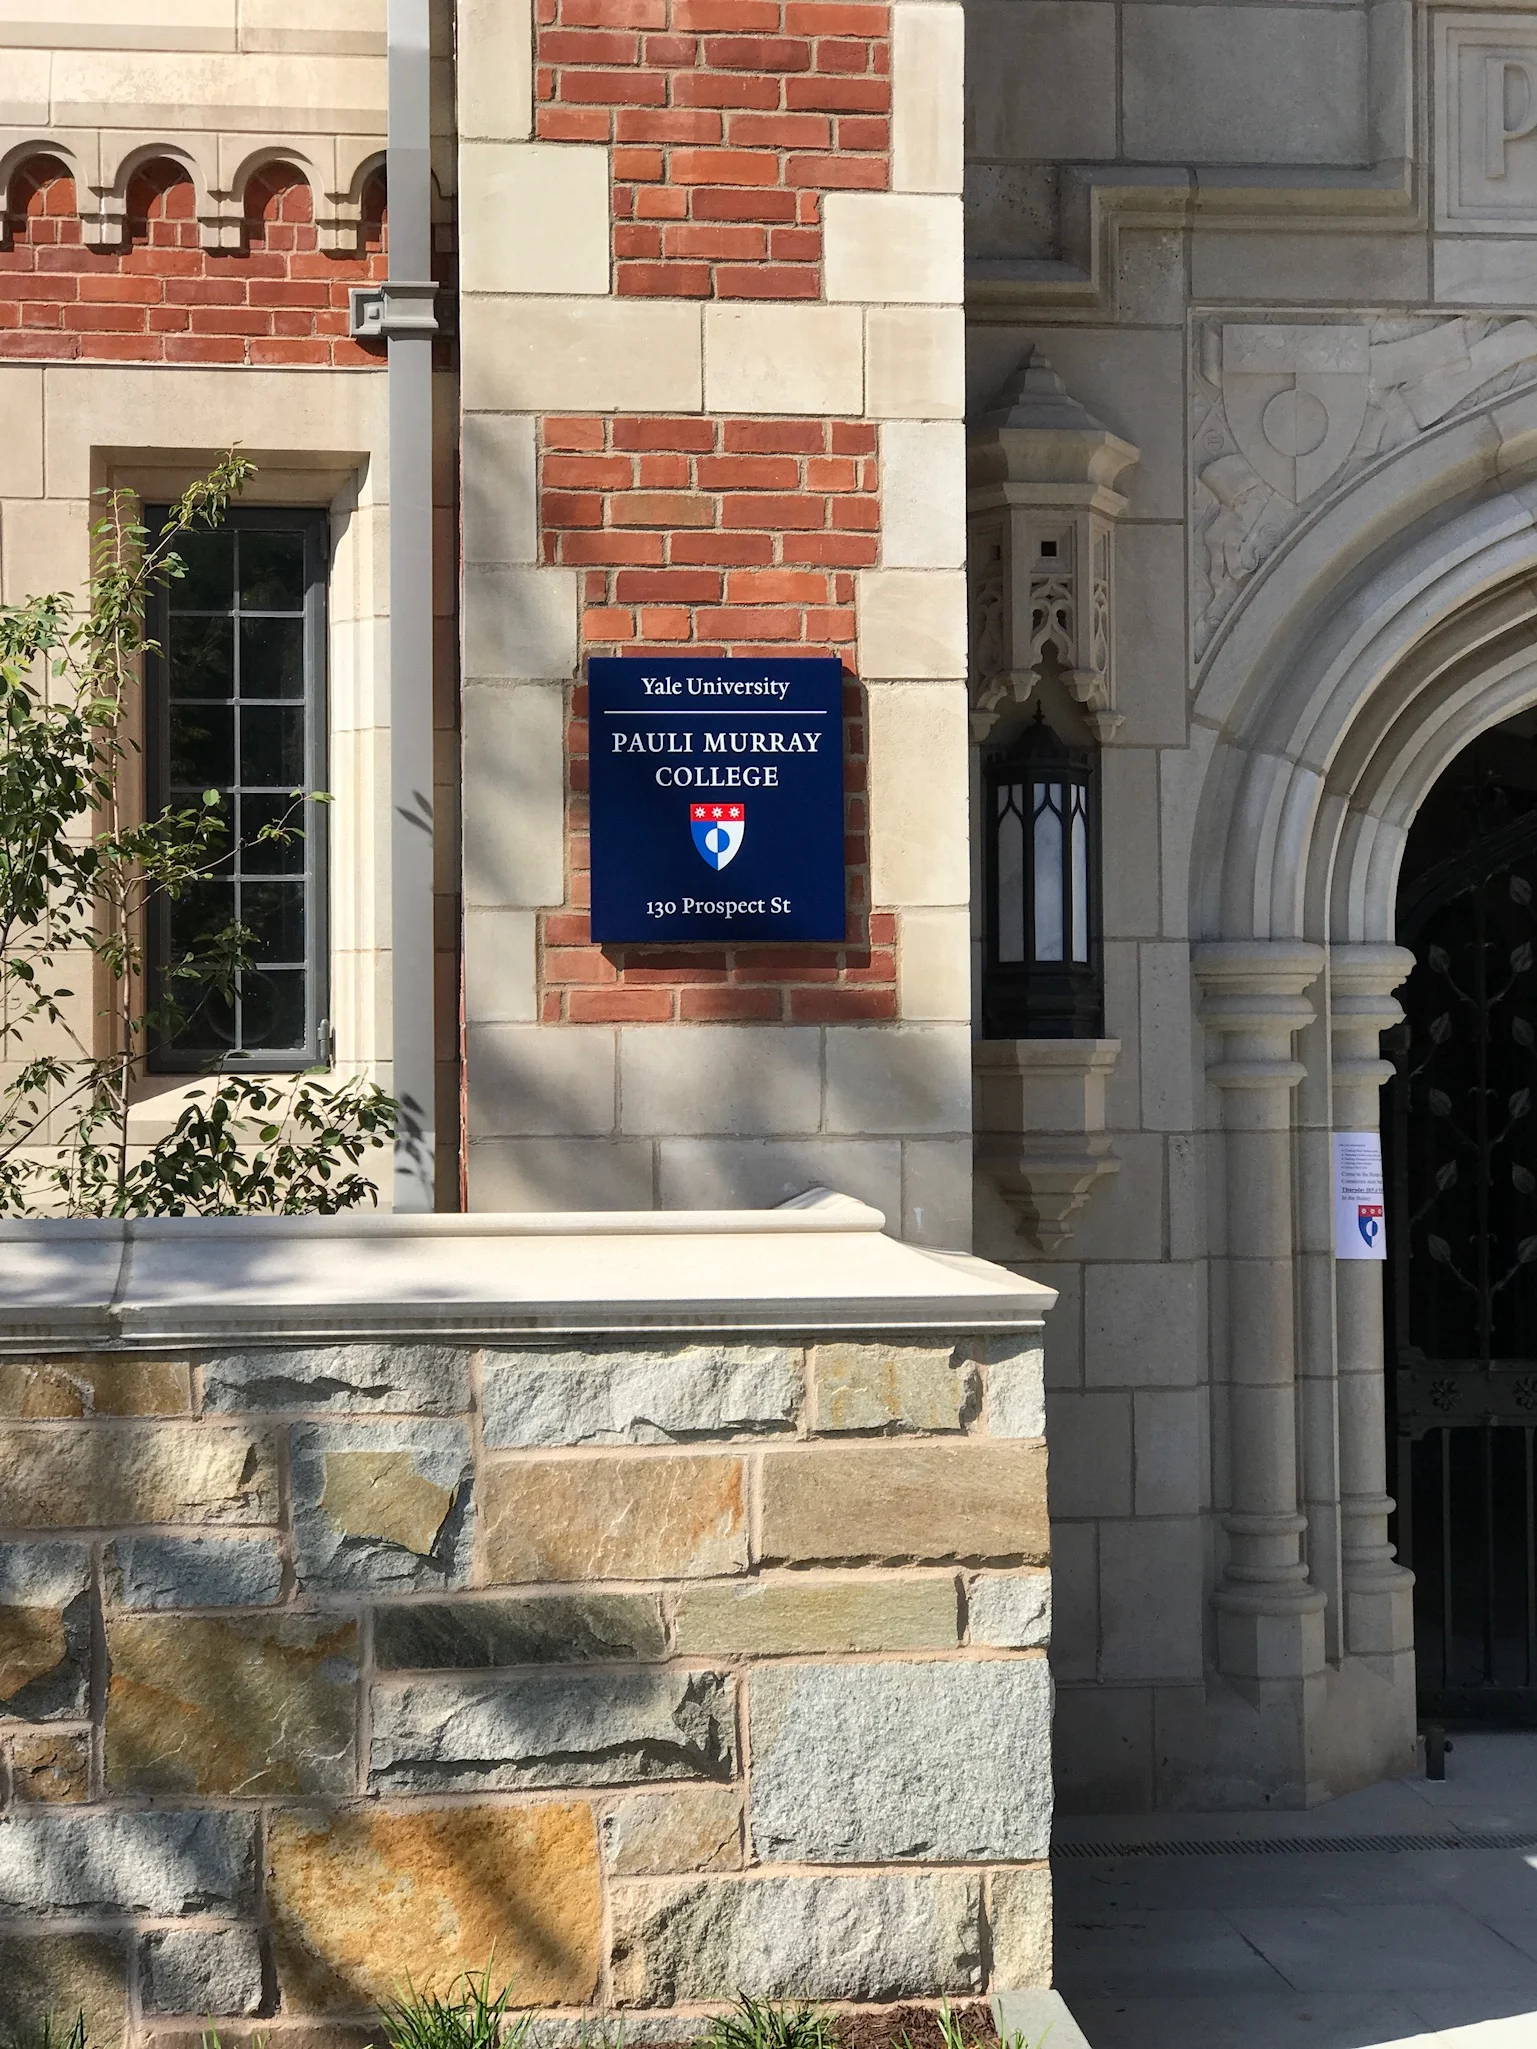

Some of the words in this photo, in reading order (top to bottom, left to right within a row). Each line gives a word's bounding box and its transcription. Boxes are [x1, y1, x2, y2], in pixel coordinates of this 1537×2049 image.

[641, 677, 682, 695] Yale
[686, 677, 790, 700] University
[611, 732, 694, 753] PAULI
[703, 732, 822, 753] MURRAY
[655, 766, 779, 787] COLLEGE
[646, 901, 676, 918] 130
[682, 897, 765, 919] Prospect
[770, 897, 792, 914] St
